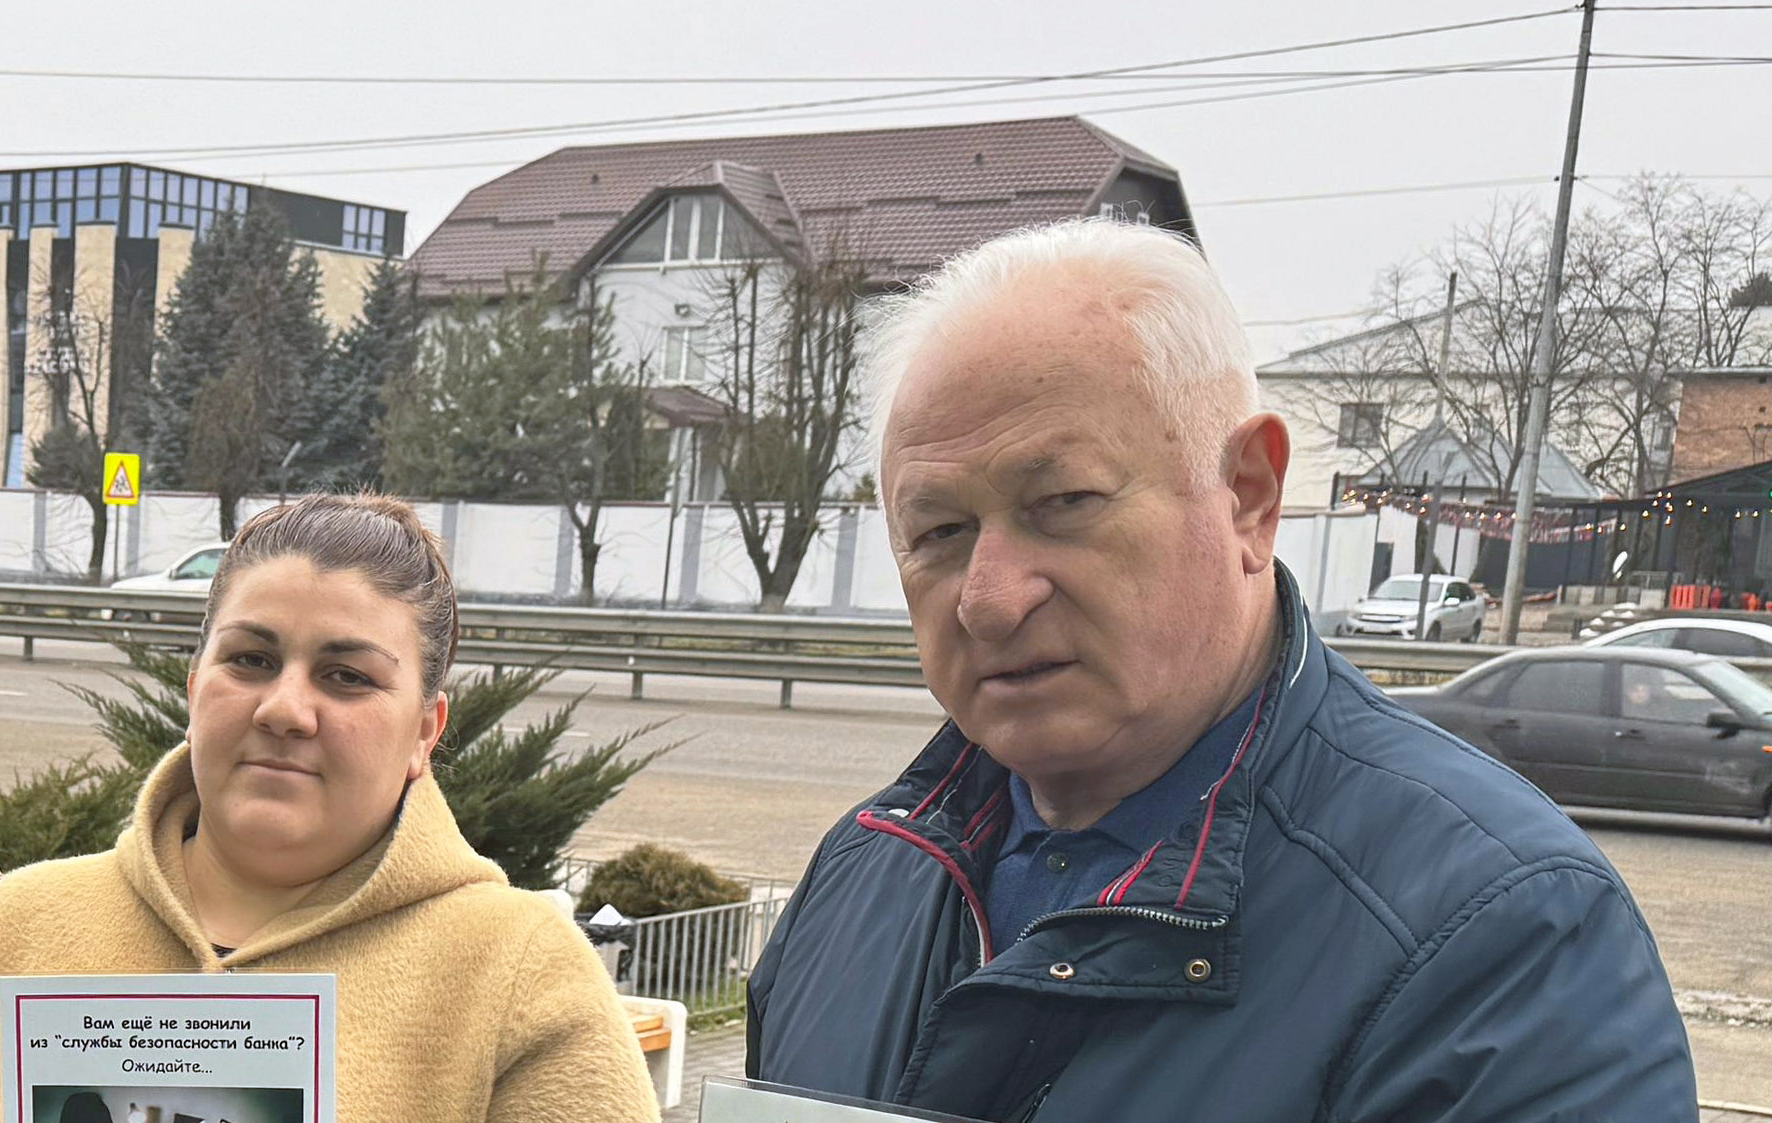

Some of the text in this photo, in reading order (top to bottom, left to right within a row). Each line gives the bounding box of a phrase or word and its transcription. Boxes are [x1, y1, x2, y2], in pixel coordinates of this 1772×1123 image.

[83, 1017, 250, 1030] Вам ещё не звонили
[30, 1038, 47, 1047] из
[128, 1037, 236, 1049] безопасности
[122, 1059, 212, 1072] Ожидайте...
